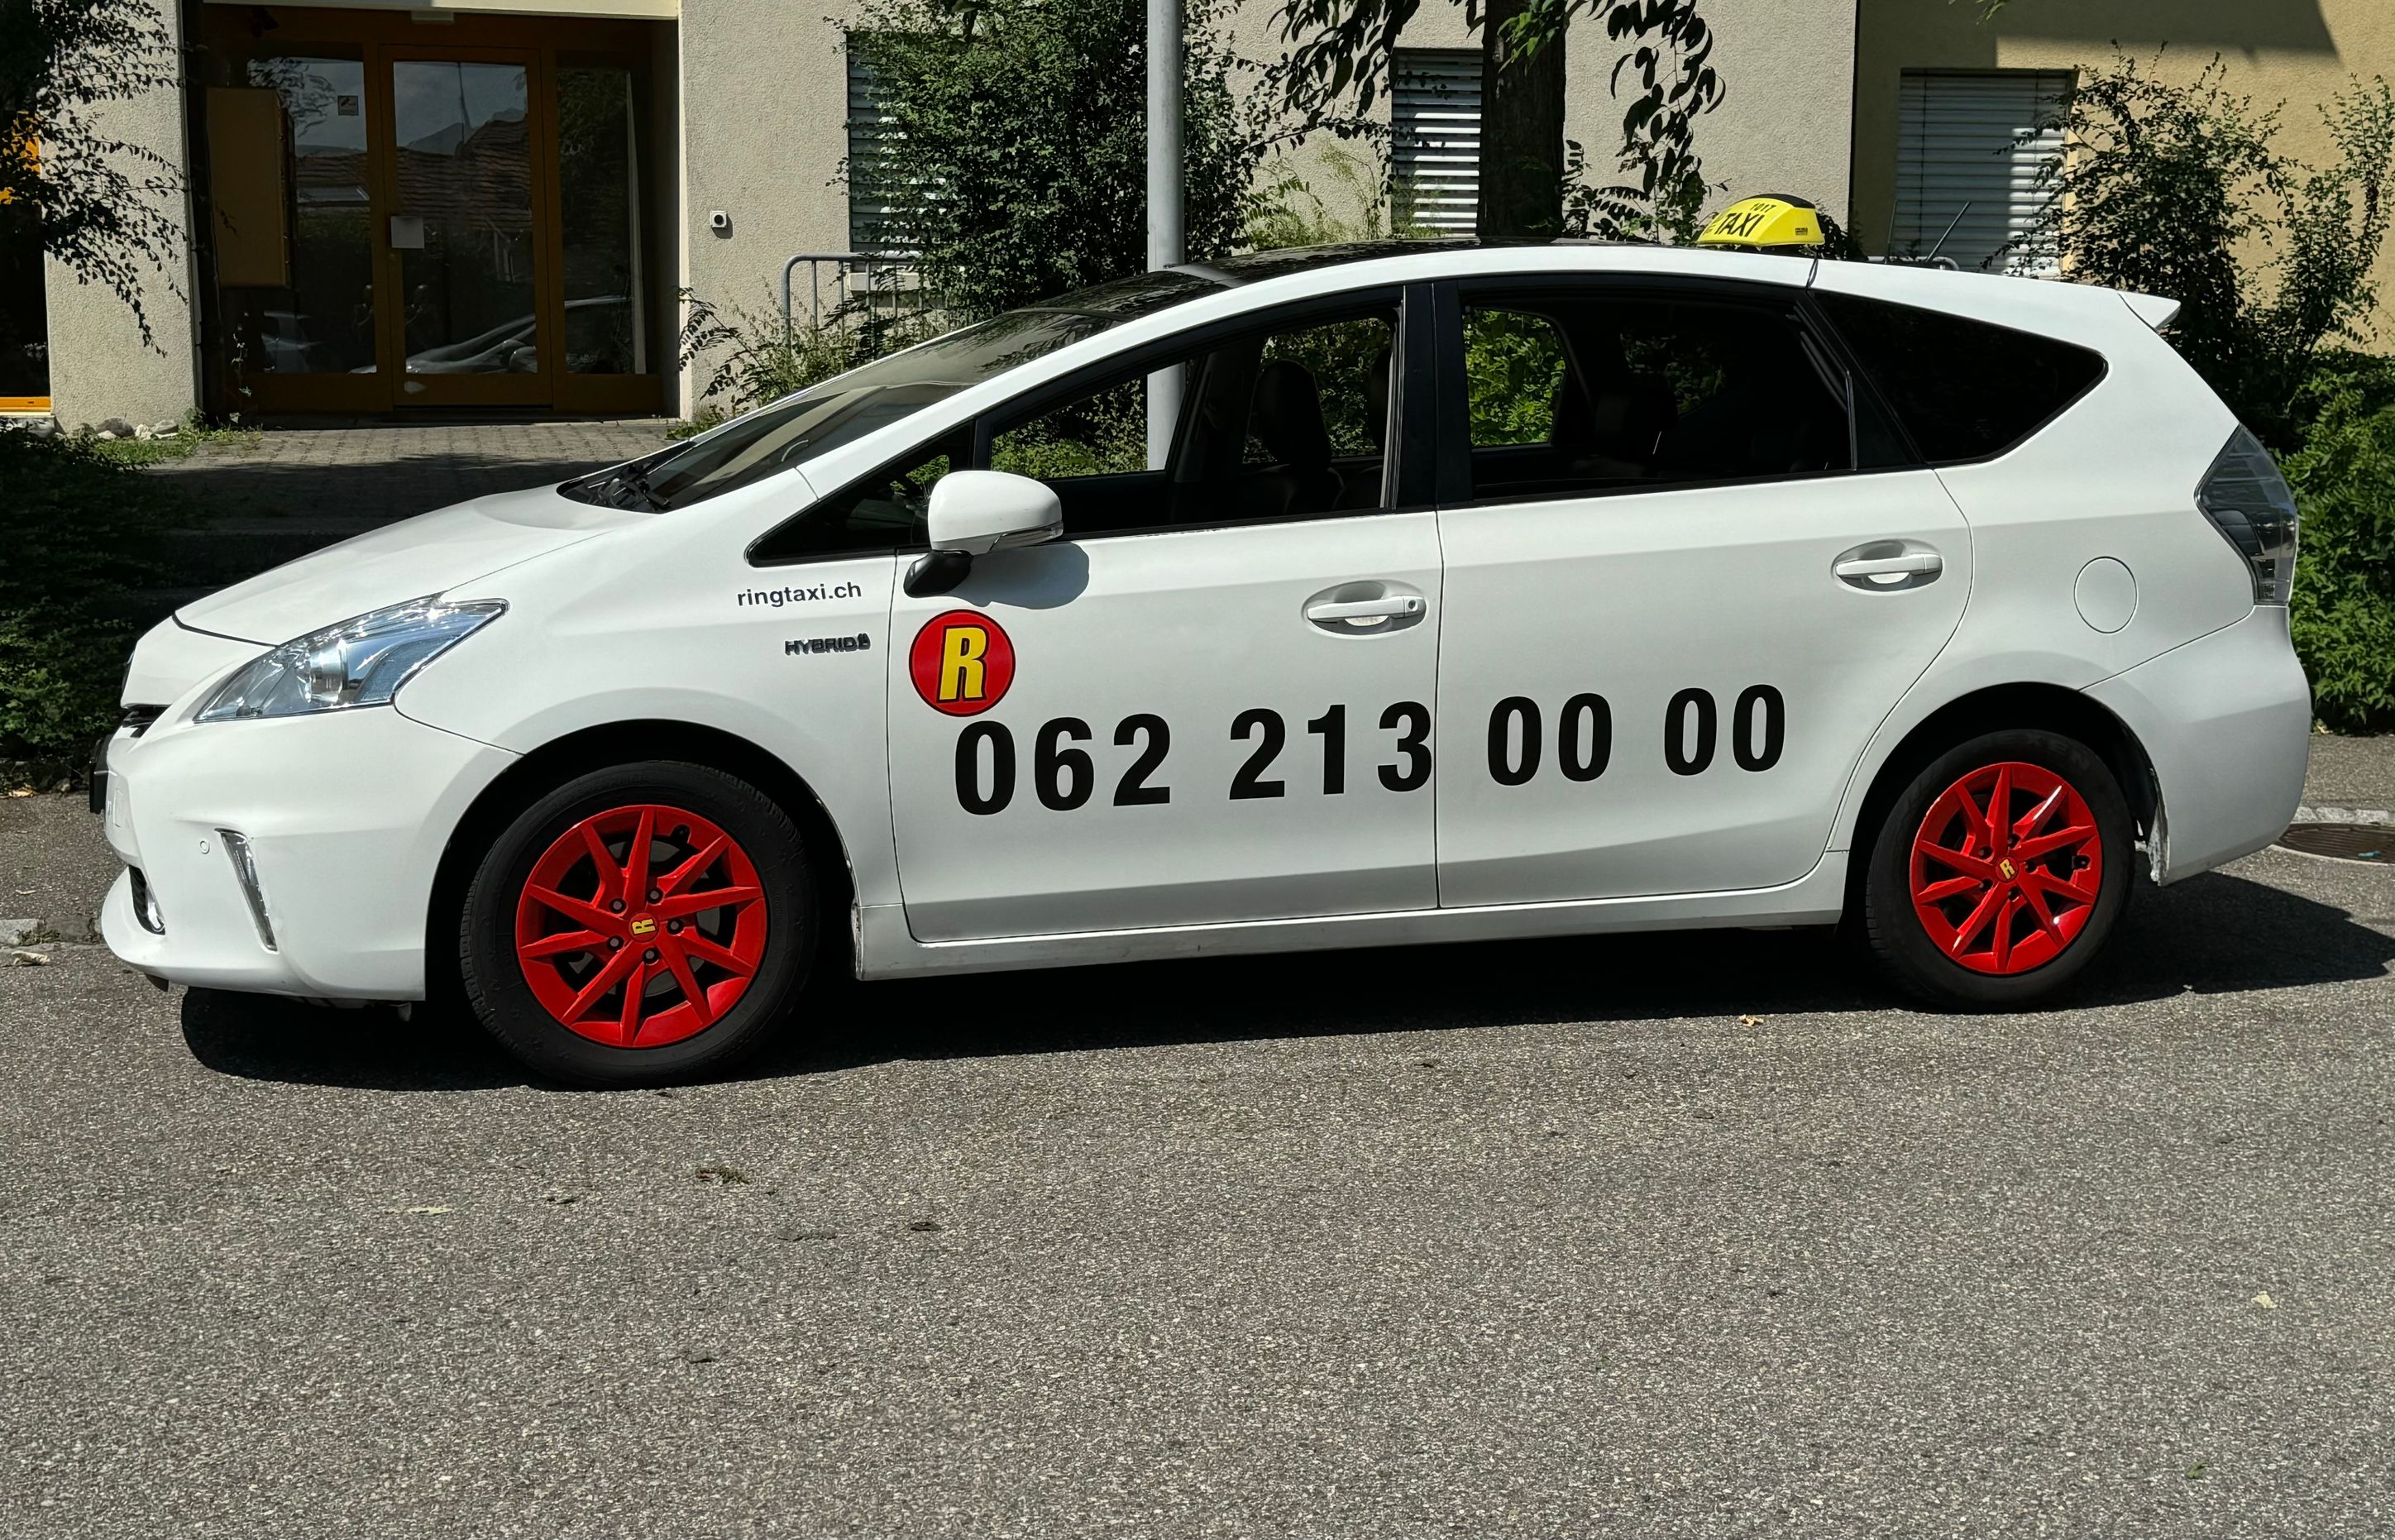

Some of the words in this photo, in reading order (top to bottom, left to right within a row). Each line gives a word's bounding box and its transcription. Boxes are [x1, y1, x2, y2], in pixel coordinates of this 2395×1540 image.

[1715, 213, 1765, 237] TAXI
[737, 581, 862, 607] ringtaxi.ch
[785, 636, 858, 656] HYBRID
[936, 624, 990, 704] R
[954, 713, 1171, 815] 062
[1228, 701, 1432, 801] 213
[1488, 692, 1613, 787] 00
[1664, 684, 1785, 777] 00
[1999, 858, 2015, 880] R
